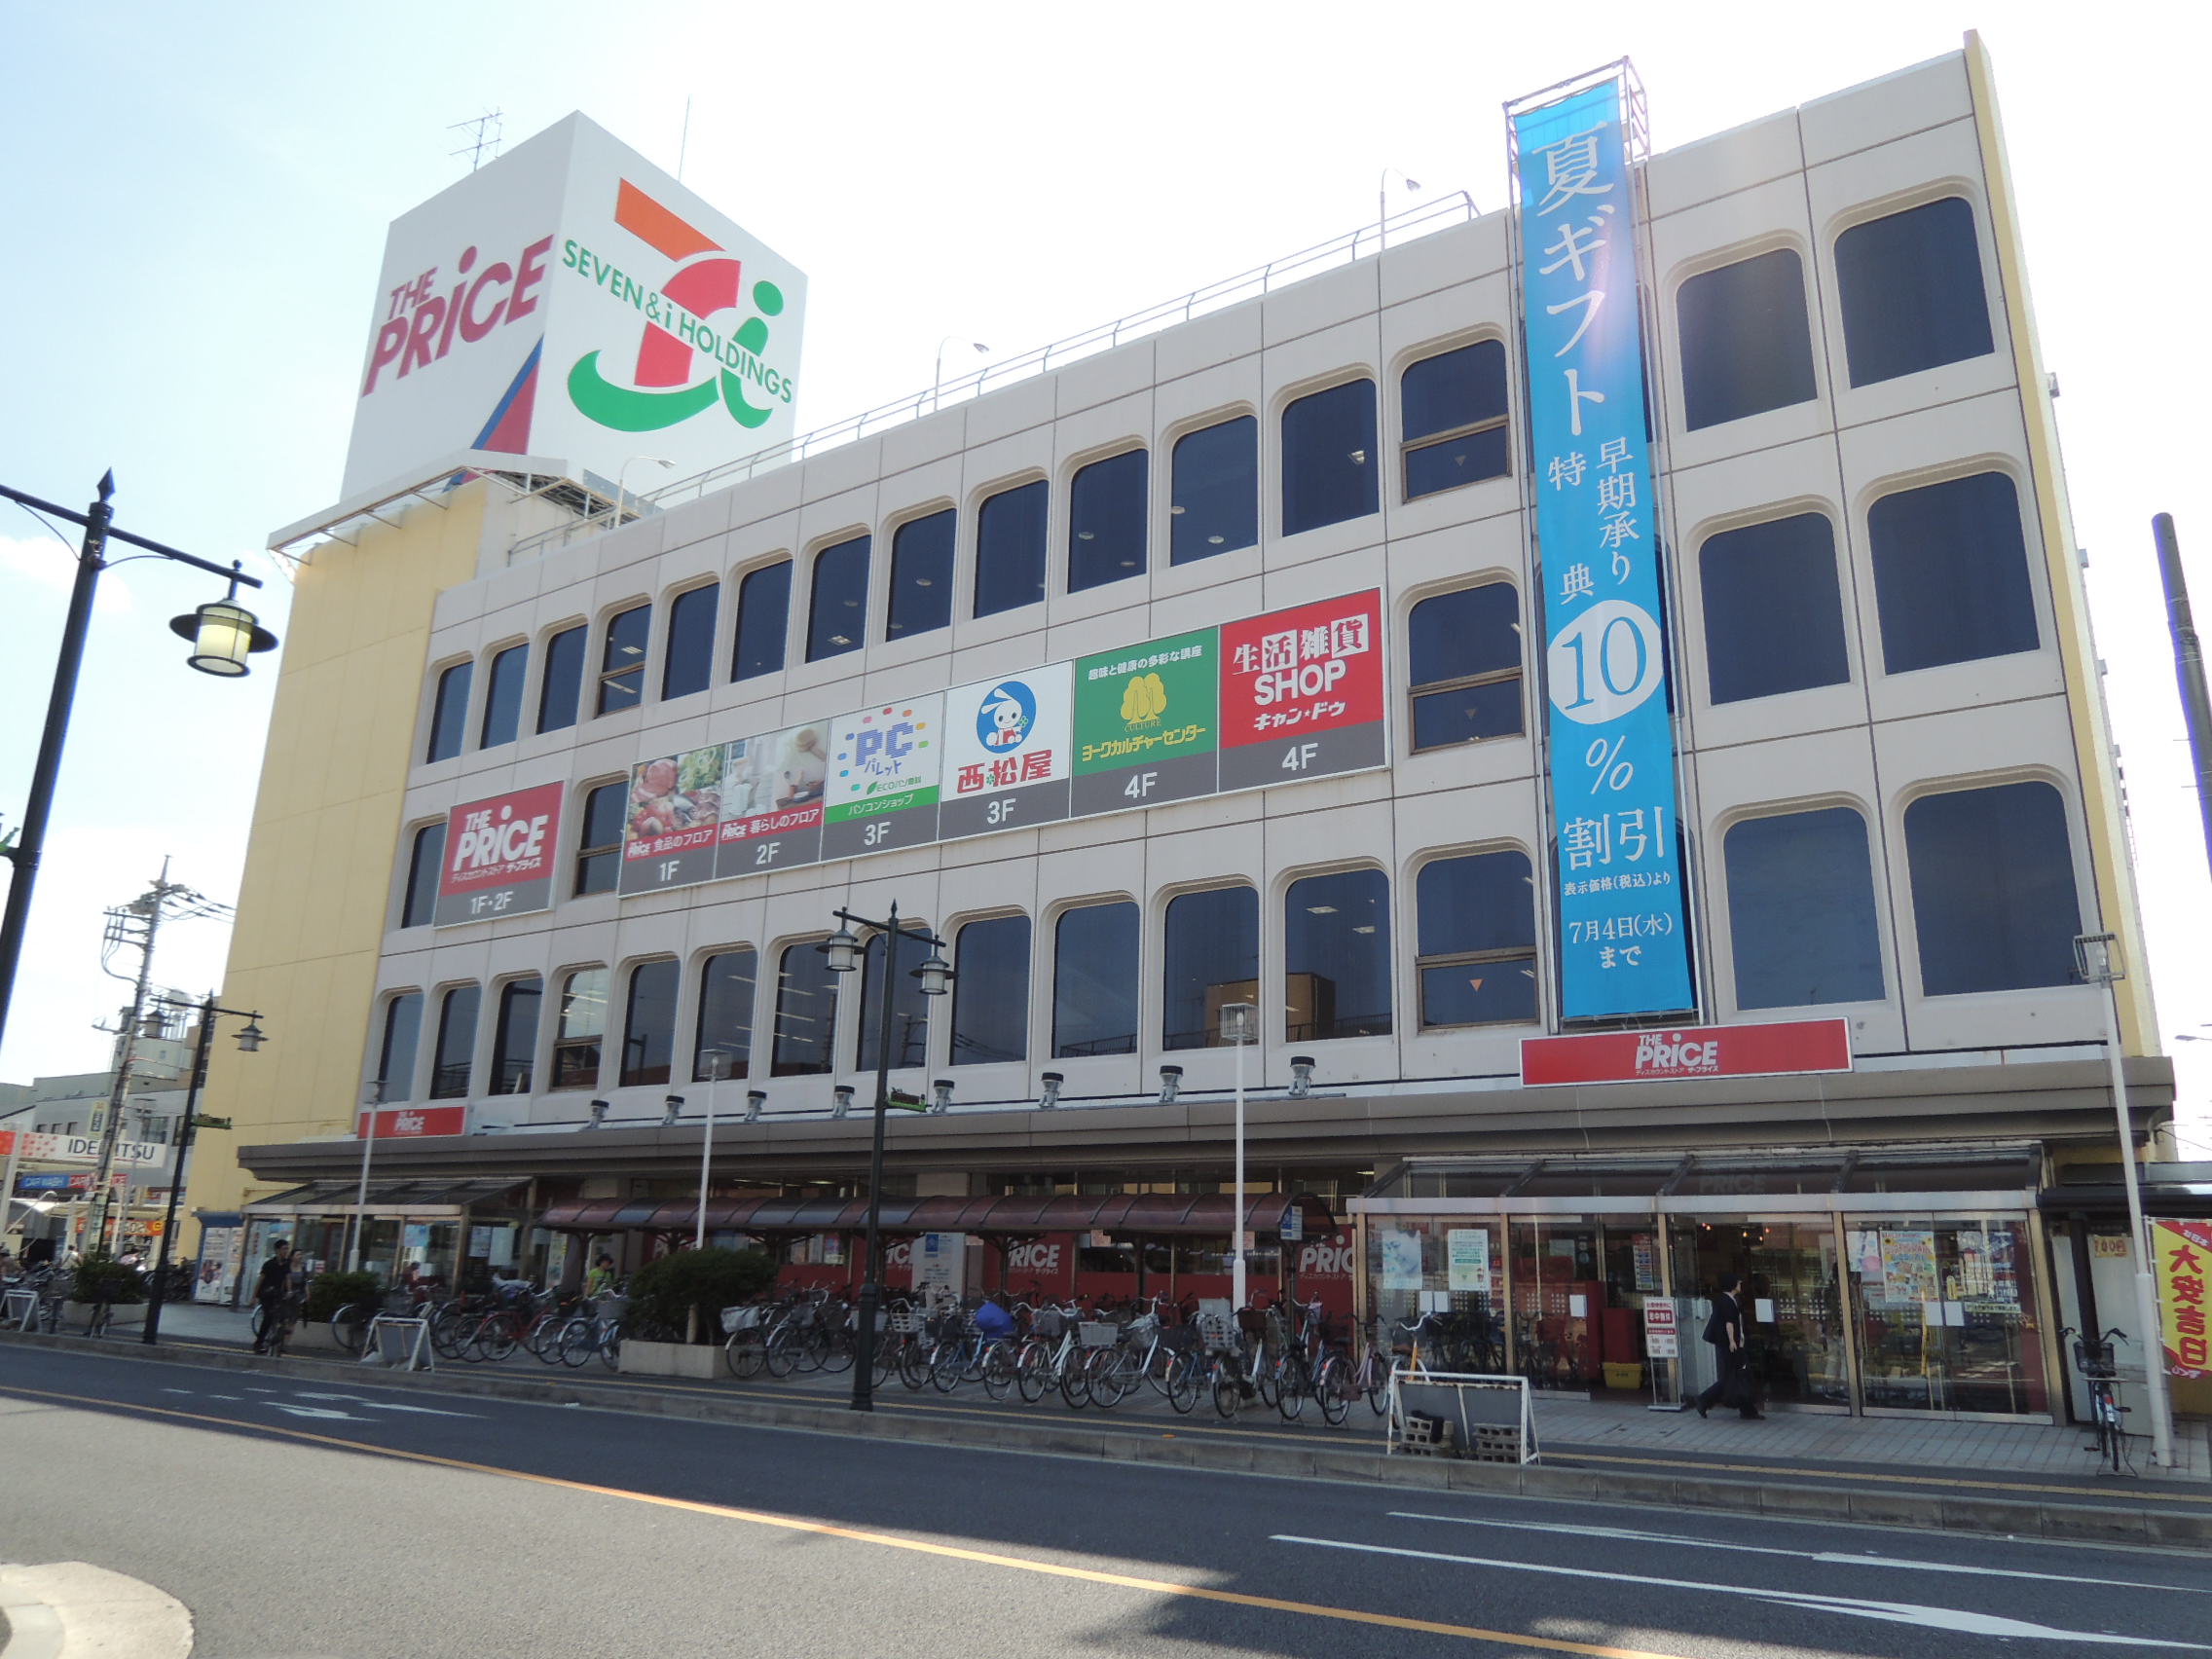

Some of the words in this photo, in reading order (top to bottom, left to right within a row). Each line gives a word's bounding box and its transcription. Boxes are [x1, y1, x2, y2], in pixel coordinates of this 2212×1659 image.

[1531, 121, 1614, 436] 夏ギフト
[389, 267, 438, 320] THE
[682, 313, 793, 403] HOLDINGS
[1596, 436, 1640, 585] 早期承り
[1233, 613, 1369, 676] 生活雑貨
[1088, 645, 1203, 681] 趣味と健康の多彩な講座
[1254, 659, 1346, 706] SHOP
[855, 722, 914, 766] PC
[1082, 724, 1206, 762] ヨークカルチャーセンター
[865, 758, 902, 777] パレット
[1281, 743, 1319, 771] 4F
[957, 750, 1052, 793] 西松屋
[1124, 772, 1159, 798] 4F
[849, 793, 913, 816] パソコンショップ
[986, 798, 1016, 824] 3F
[465, 810, 492, 831] THE
[750, 808, 820, 834] 暮らしのフロア
[864, 822, 892, 845] 3F
[653, 829, 714, 852] 食品のフロア
[1563, 806, 1664, 870] 割引
[756, 842, 781, 866] 2F
[659, 860, 680, 882] 1F
[1565, 871, 1671, 896] 表示価格(税込)より
[1568, 912, 1673, 944] 7月4日(水)
[1600, 945, 1641, 969] まで
[1640, 1034, 1663, 1047] THE
[67, 1138, 156, 1161] IDEITSU
